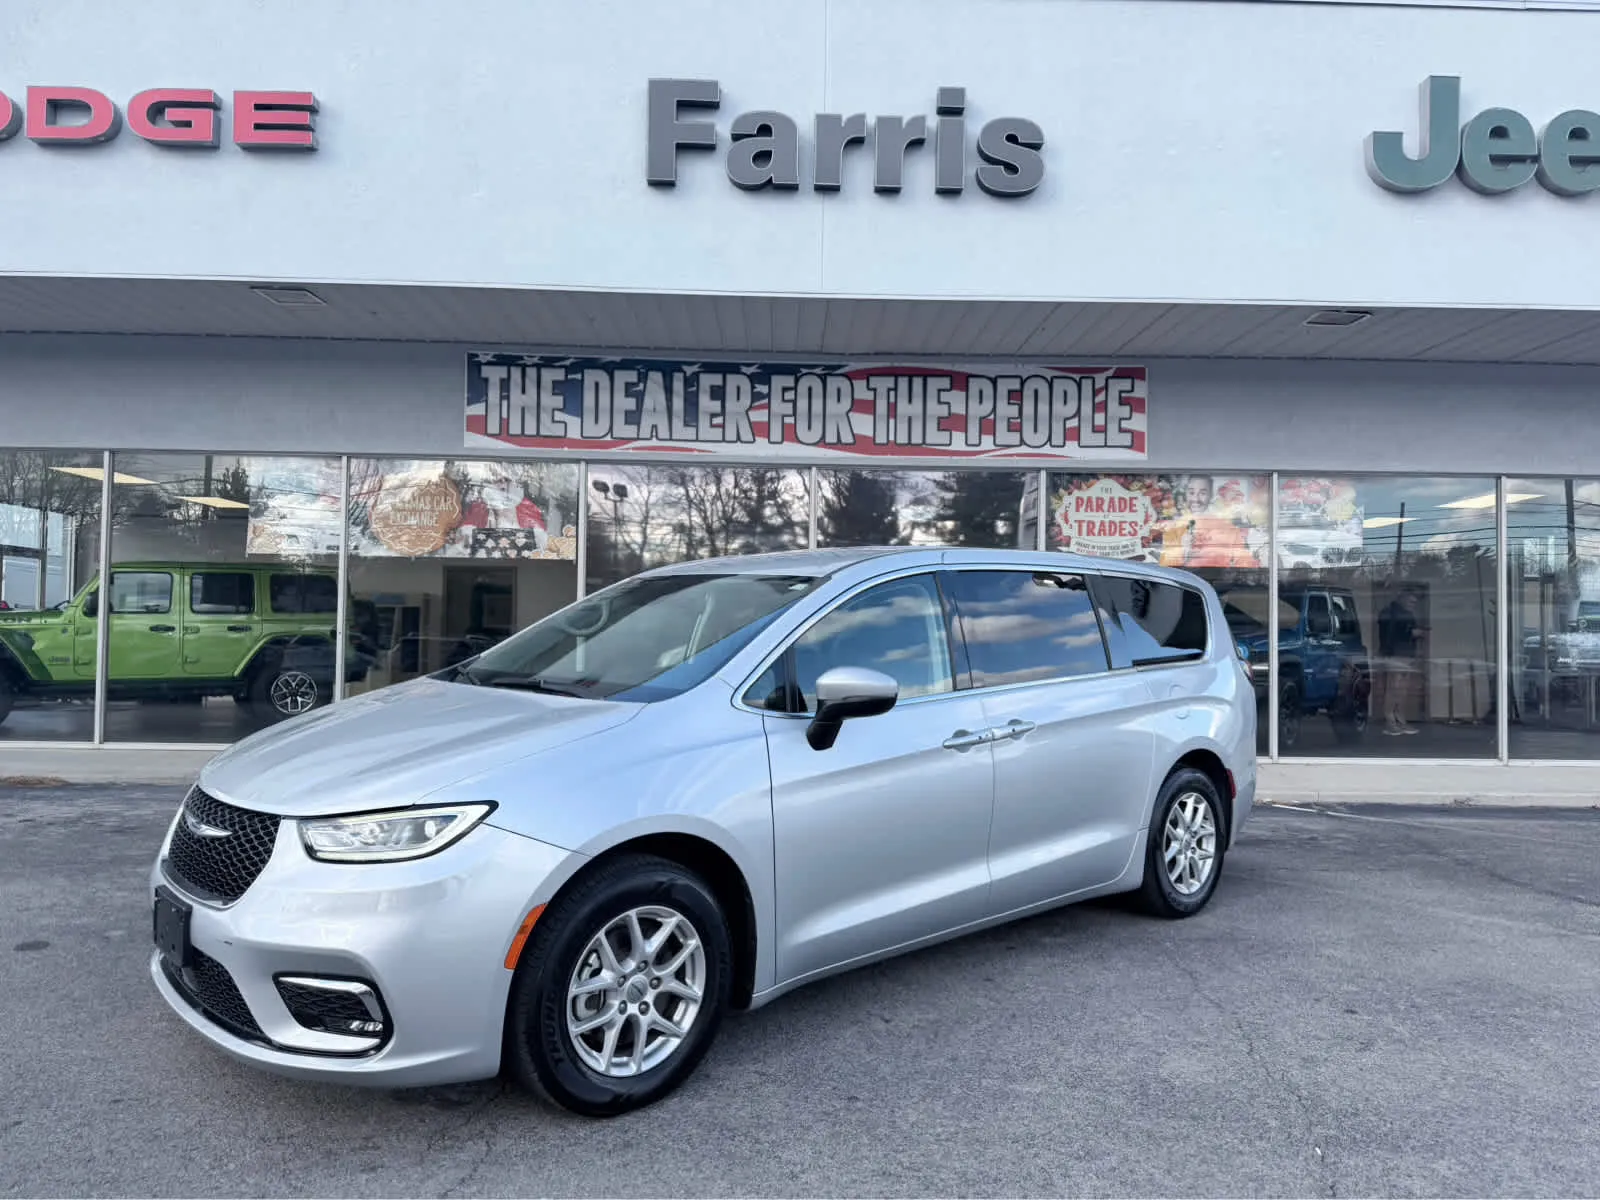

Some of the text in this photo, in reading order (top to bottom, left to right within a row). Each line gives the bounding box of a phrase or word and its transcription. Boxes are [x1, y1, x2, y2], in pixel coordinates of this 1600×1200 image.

[0, 85, 320, 151] DGE
[647, 78, 1045, 197] Farris
[481, 365, 1134, 448] THE DEALER FOR THE PEOPLE
[1074, 520, 1139, 537] TRADES
[1075, 496, 1138, 513] PARADE
